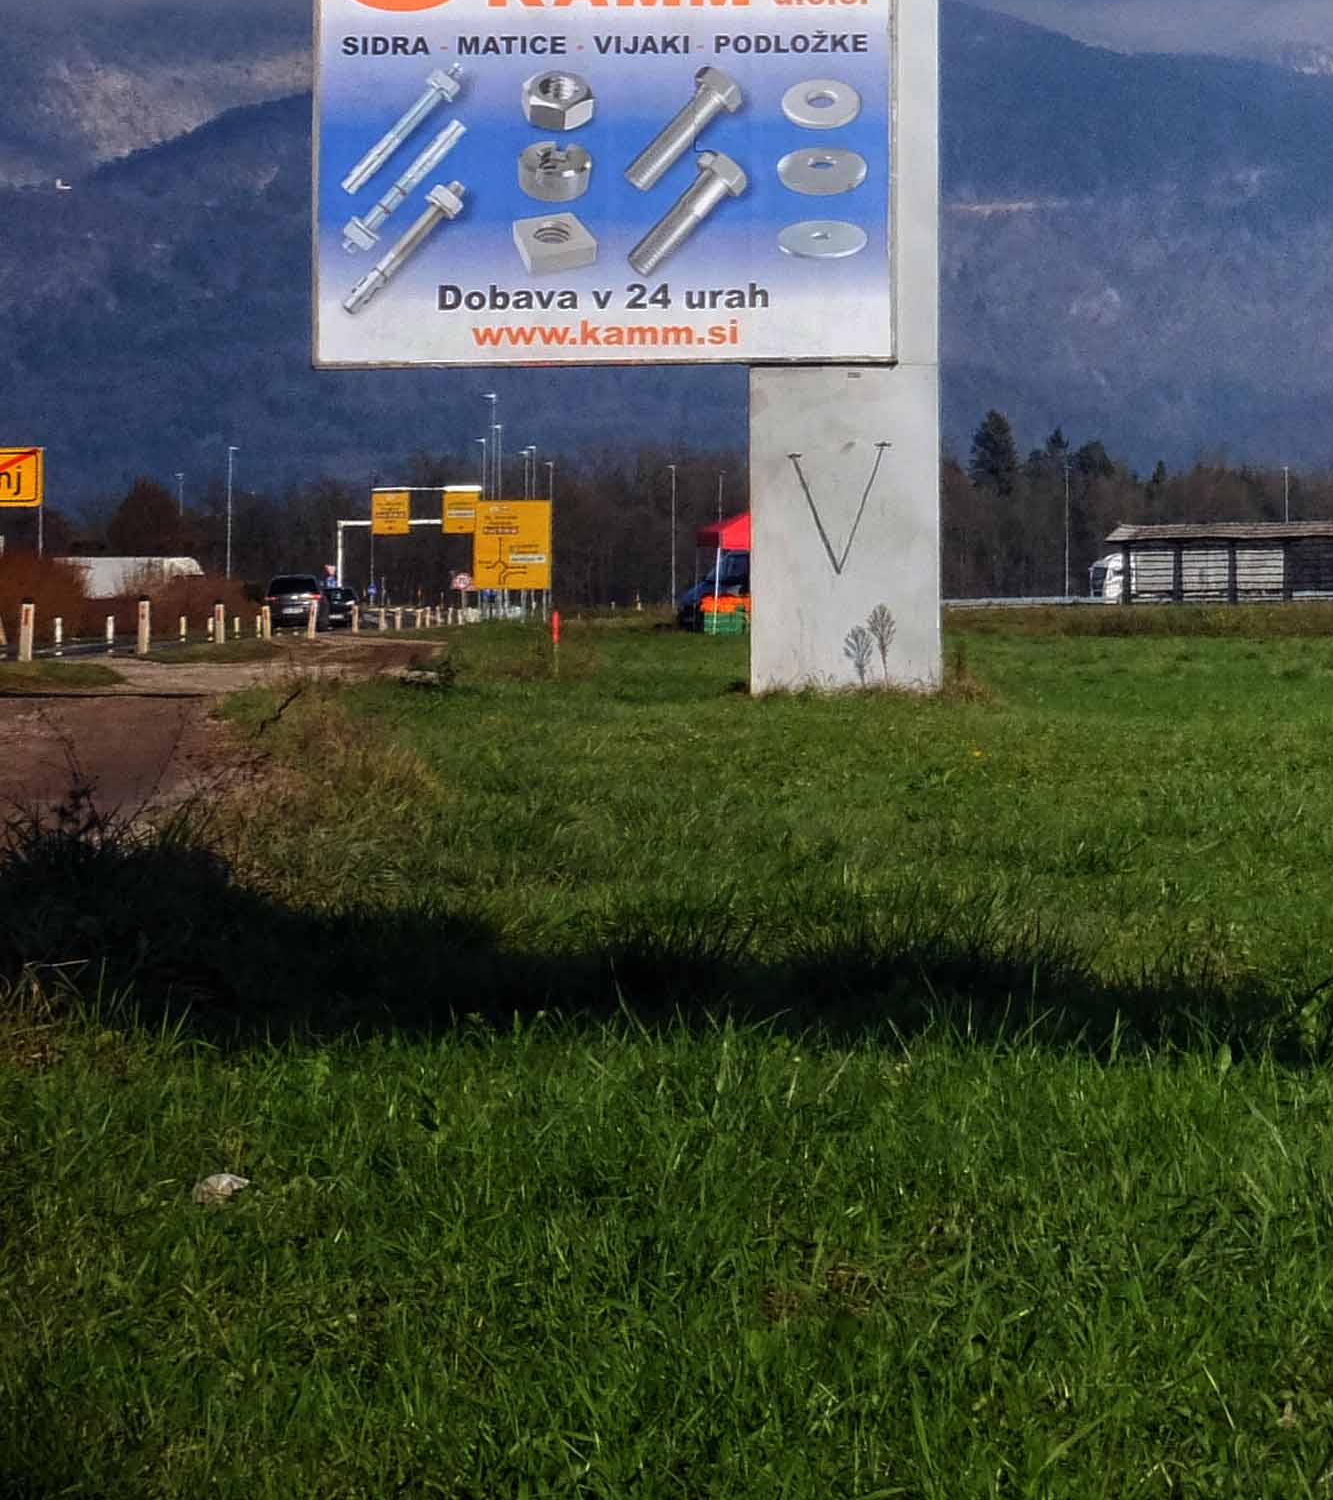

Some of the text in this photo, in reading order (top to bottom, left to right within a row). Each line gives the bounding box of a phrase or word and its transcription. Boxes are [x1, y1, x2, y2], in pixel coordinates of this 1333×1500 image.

[341, 29, 868, 56] SIDRA MATICE VIJAKI PODLOŽKE
[437, 283, 770, 312] Dobava v 24 urah
[474, 318, 740, 347] www.kamm.si
